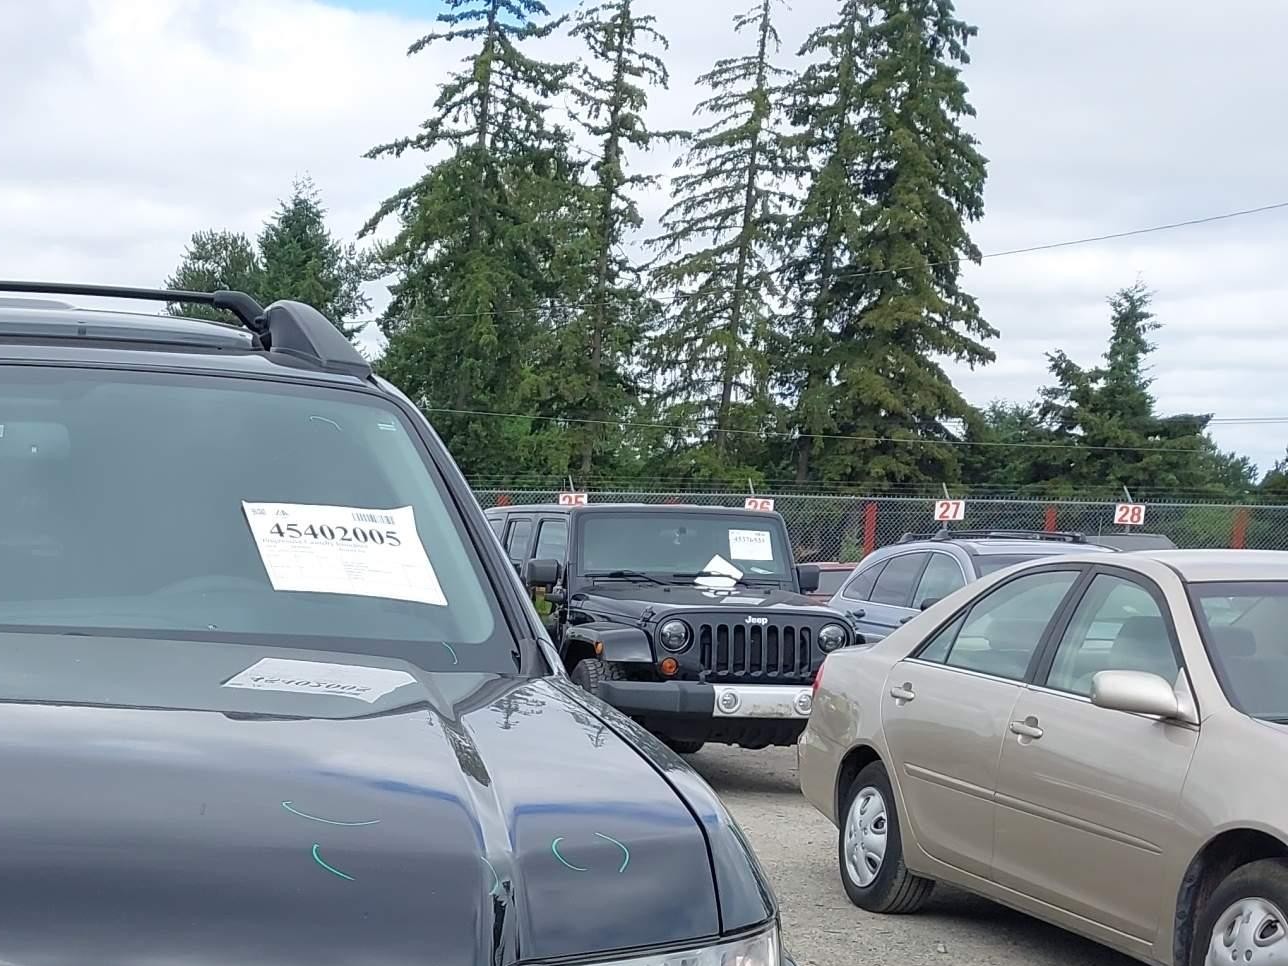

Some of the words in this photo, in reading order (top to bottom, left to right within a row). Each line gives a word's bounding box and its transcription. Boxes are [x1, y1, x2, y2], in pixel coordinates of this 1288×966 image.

[938, 502, 961, 519] 27
[1117, 506, 1142, 524] 28
[269, 522, 402, 547] 45402005
[745, 615, 769, 626] Jeep
